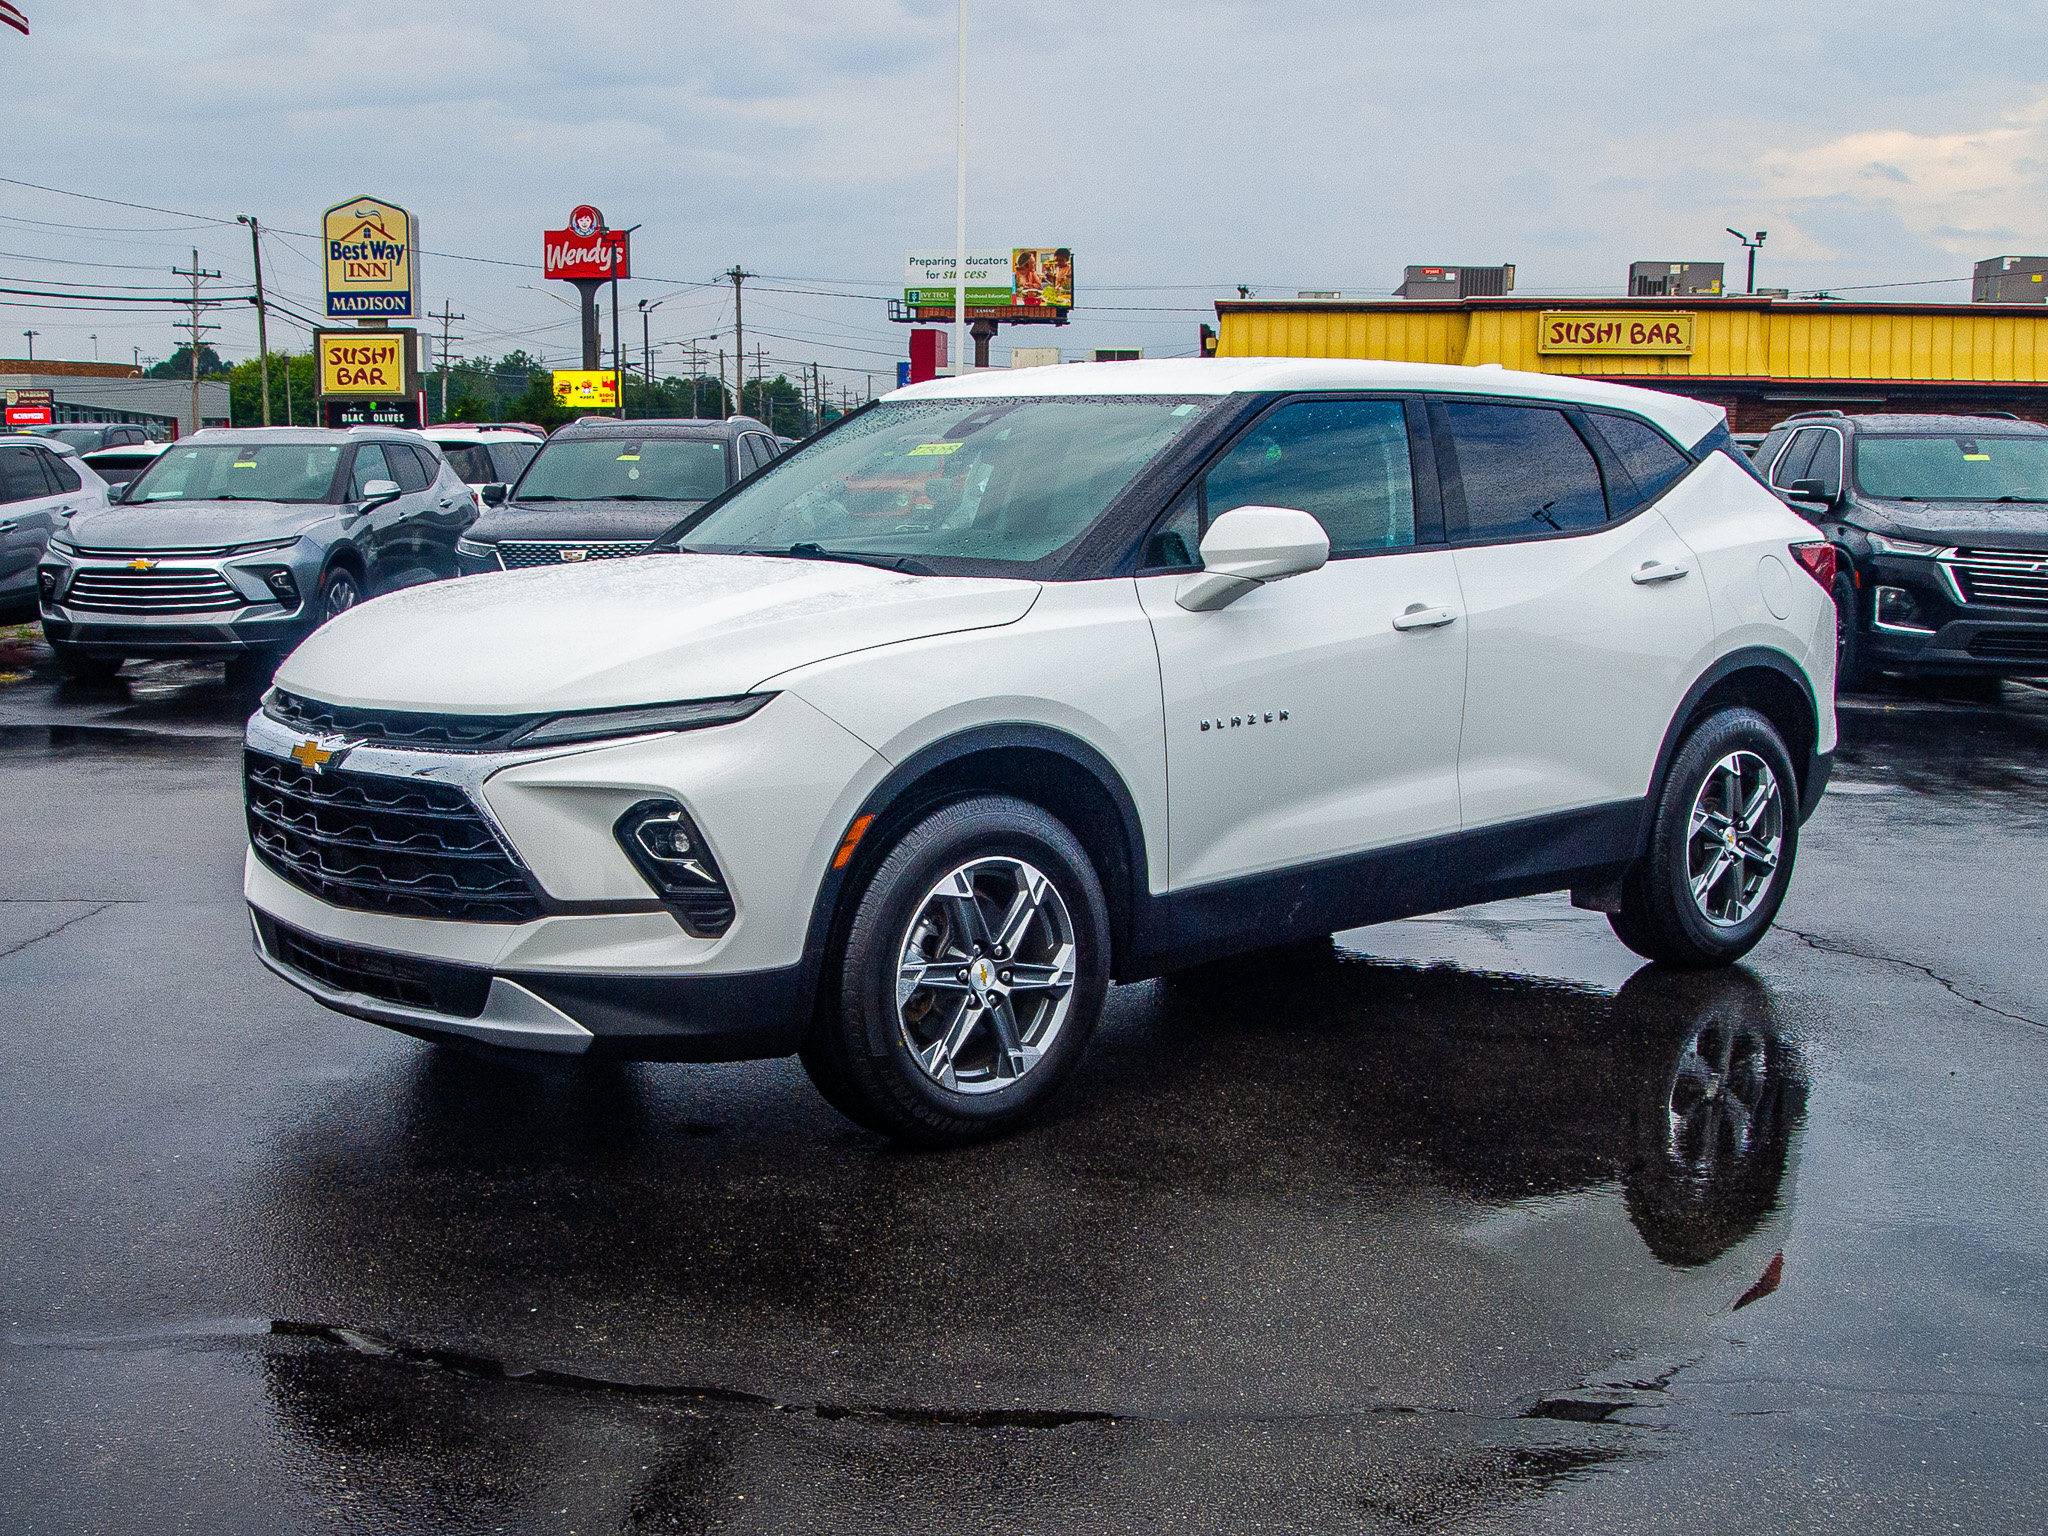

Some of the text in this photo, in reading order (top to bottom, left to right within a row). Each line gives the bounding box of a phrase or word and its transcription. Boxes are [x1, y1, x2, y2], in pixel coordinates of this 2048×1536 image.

[329, 240, 405, 266] Best Way
[546, 237, 624, 272] Wendy's
[909, 256, 1008, 267] Preparing ducators
[348, 262, 388, 278] INN
[926, 270, 988, 279] for sucess
[331, 296, 407, 311] MADISON
[1549, 322, 1684, 345] SUSHI BAR
[328, 346, 395, 366] SUSHI
[336, 367, 388, 386] BAR
[341, 413, 405, 423] BLAC OLIVES
[1200, 709, 1290, 732] BLAZER
